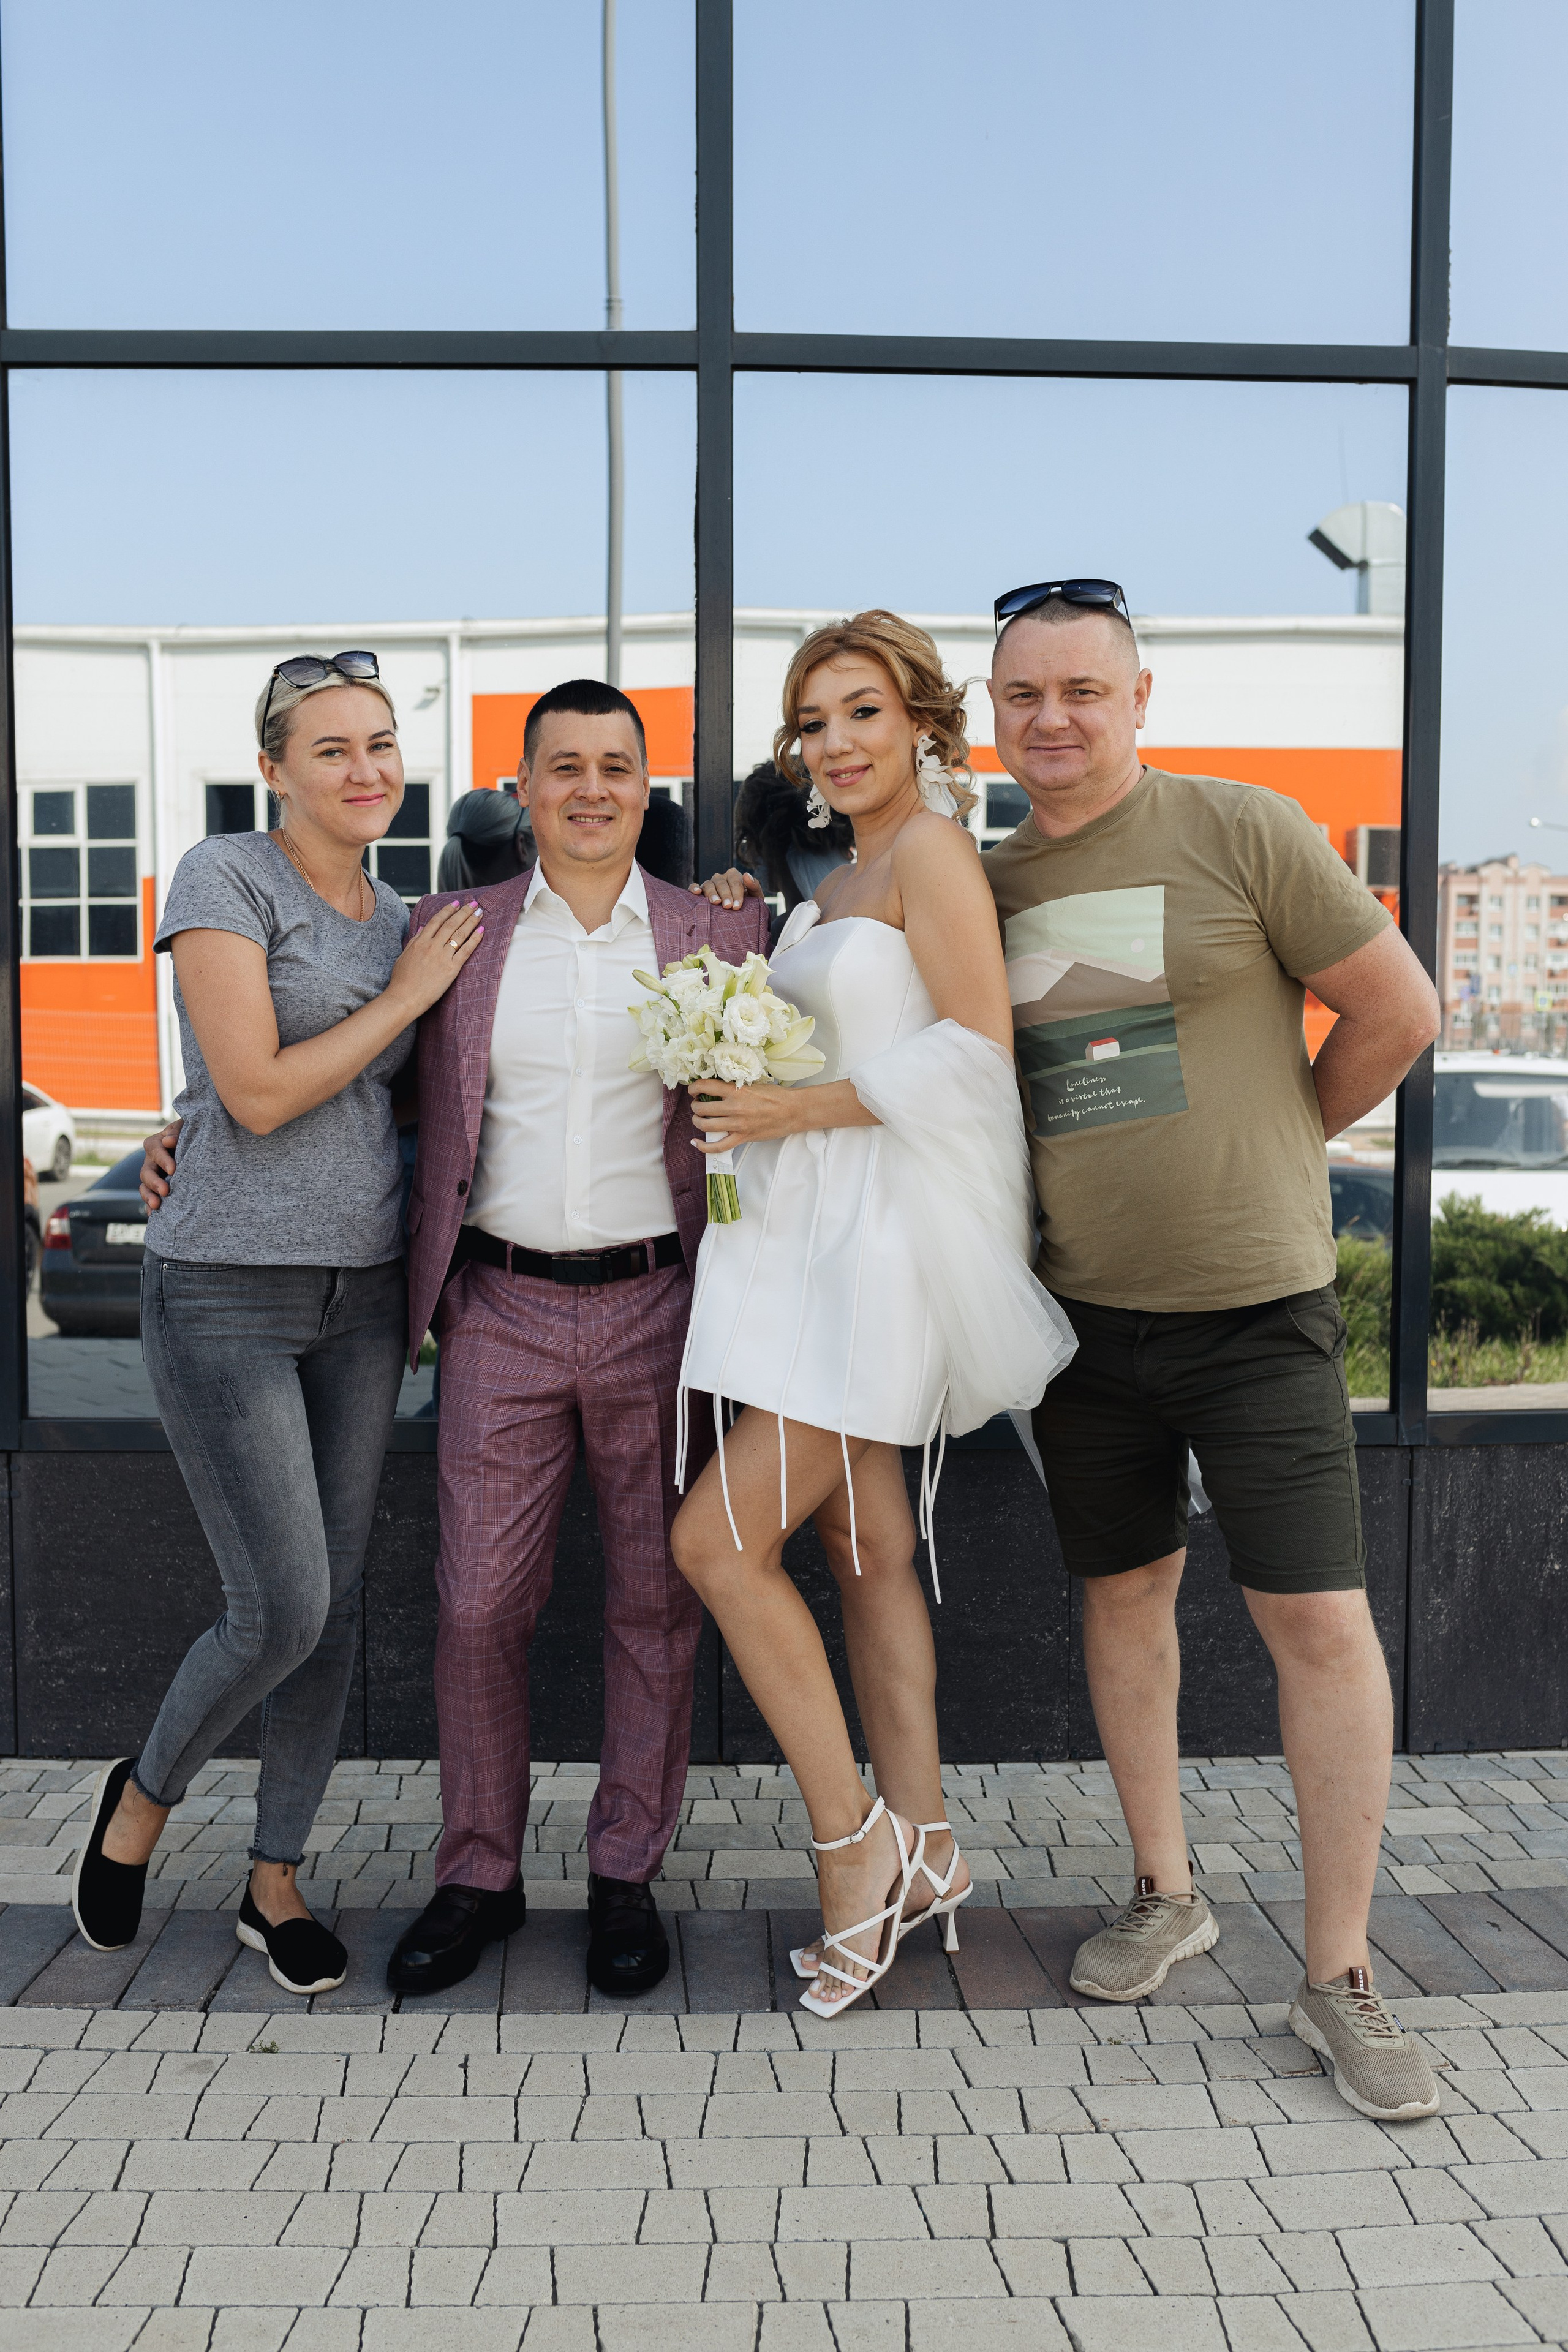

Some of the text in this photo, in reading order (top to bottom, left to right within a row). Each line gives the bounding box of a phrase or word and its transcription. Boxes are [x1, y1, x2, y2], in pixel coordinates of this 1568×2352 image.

[1066, 1076, 1107, 1092] Loneliness
[1099, 1086, 1121, 1097] that
[1047, 1097, 1146, 1122] humanity cannot escape.
